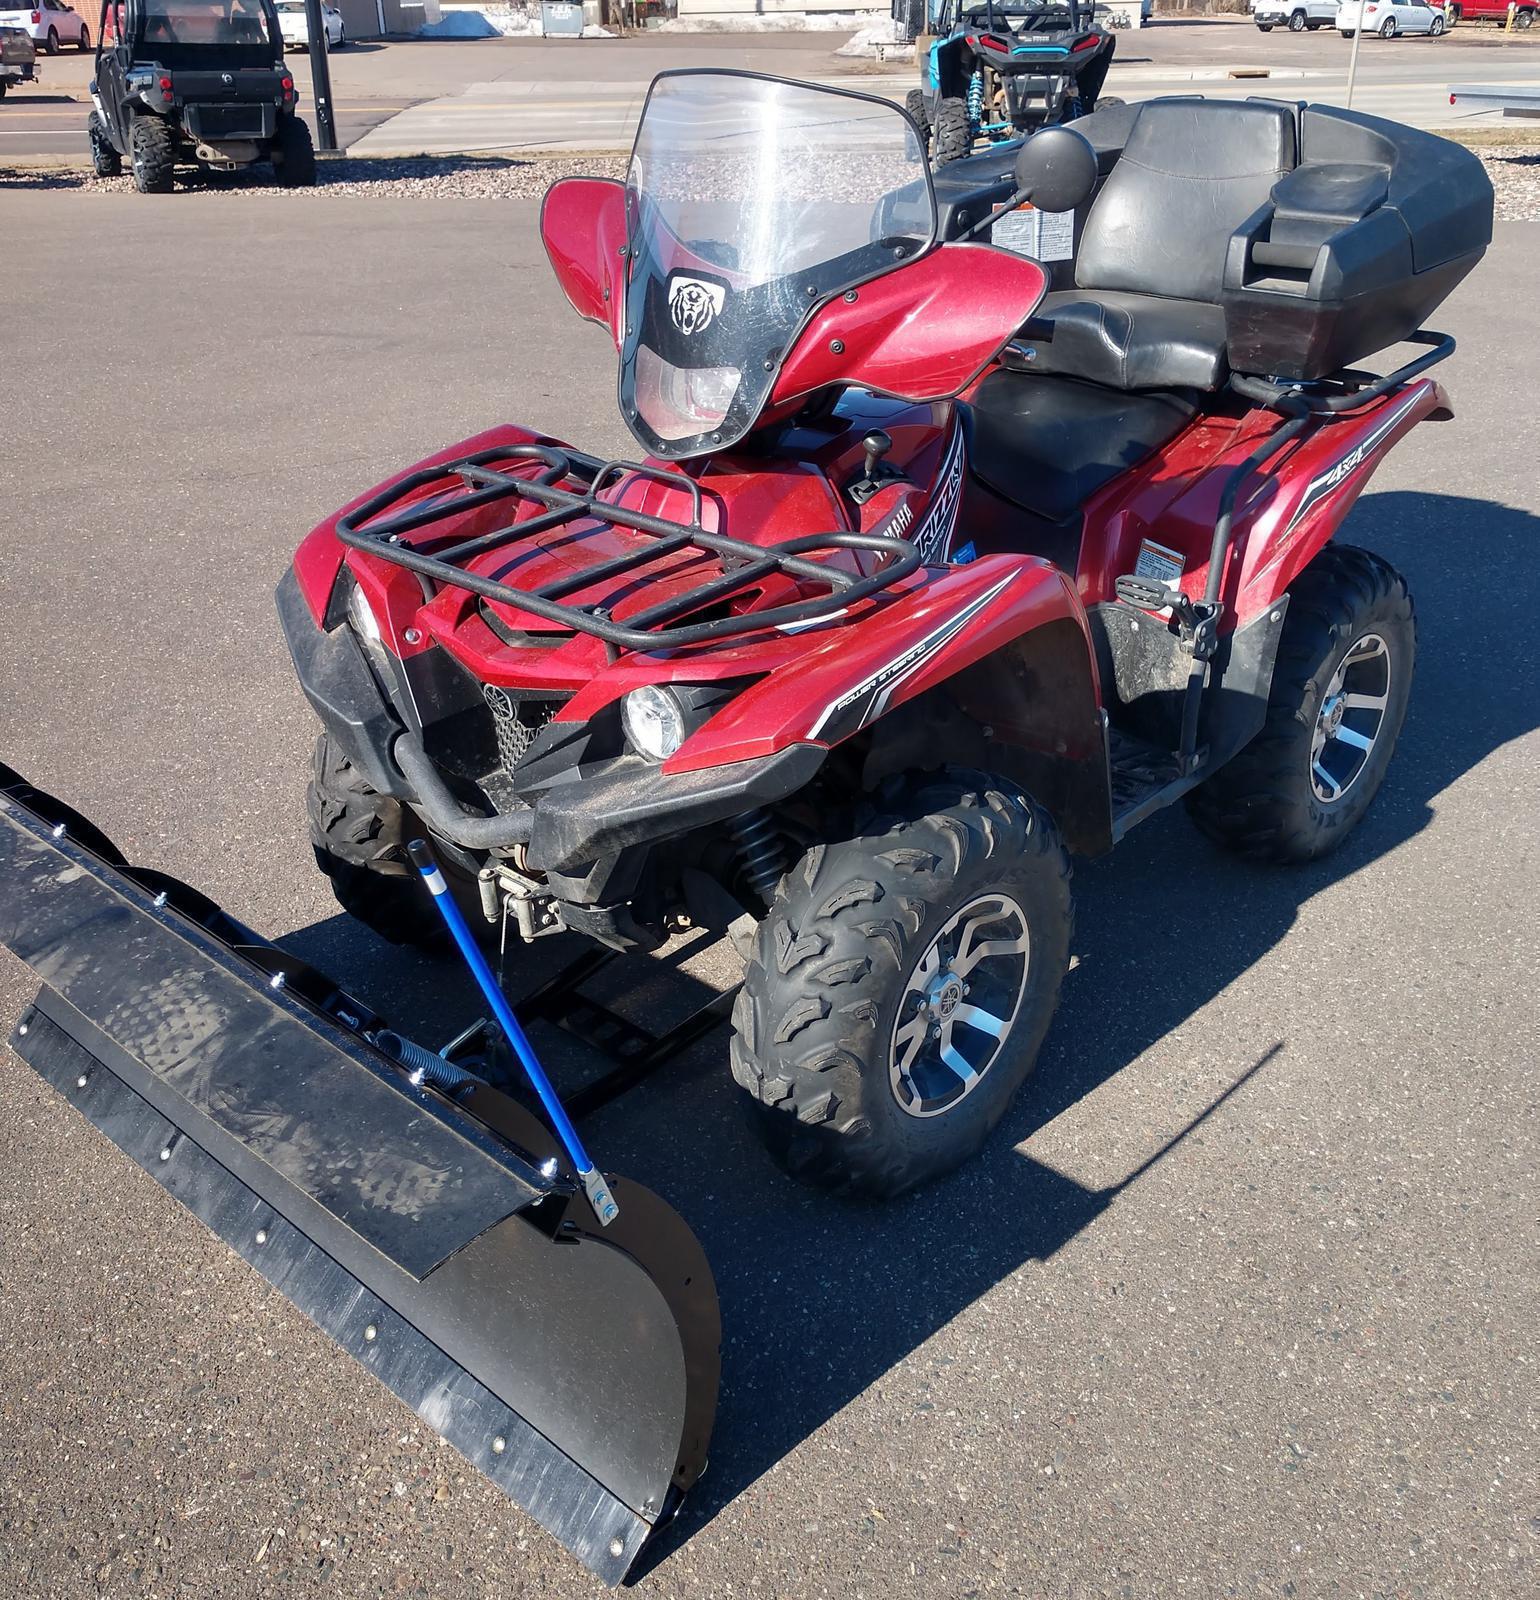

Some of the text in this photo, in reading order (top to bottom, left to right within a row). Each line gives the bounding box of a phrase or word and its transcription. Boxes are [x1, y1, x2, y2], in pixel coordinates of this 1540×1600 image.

[873, 503, 914, 562] YMAHA
[915, 455, 962, 558] RIZZLY
[838, 644, 926, 711] POWER STEERING
